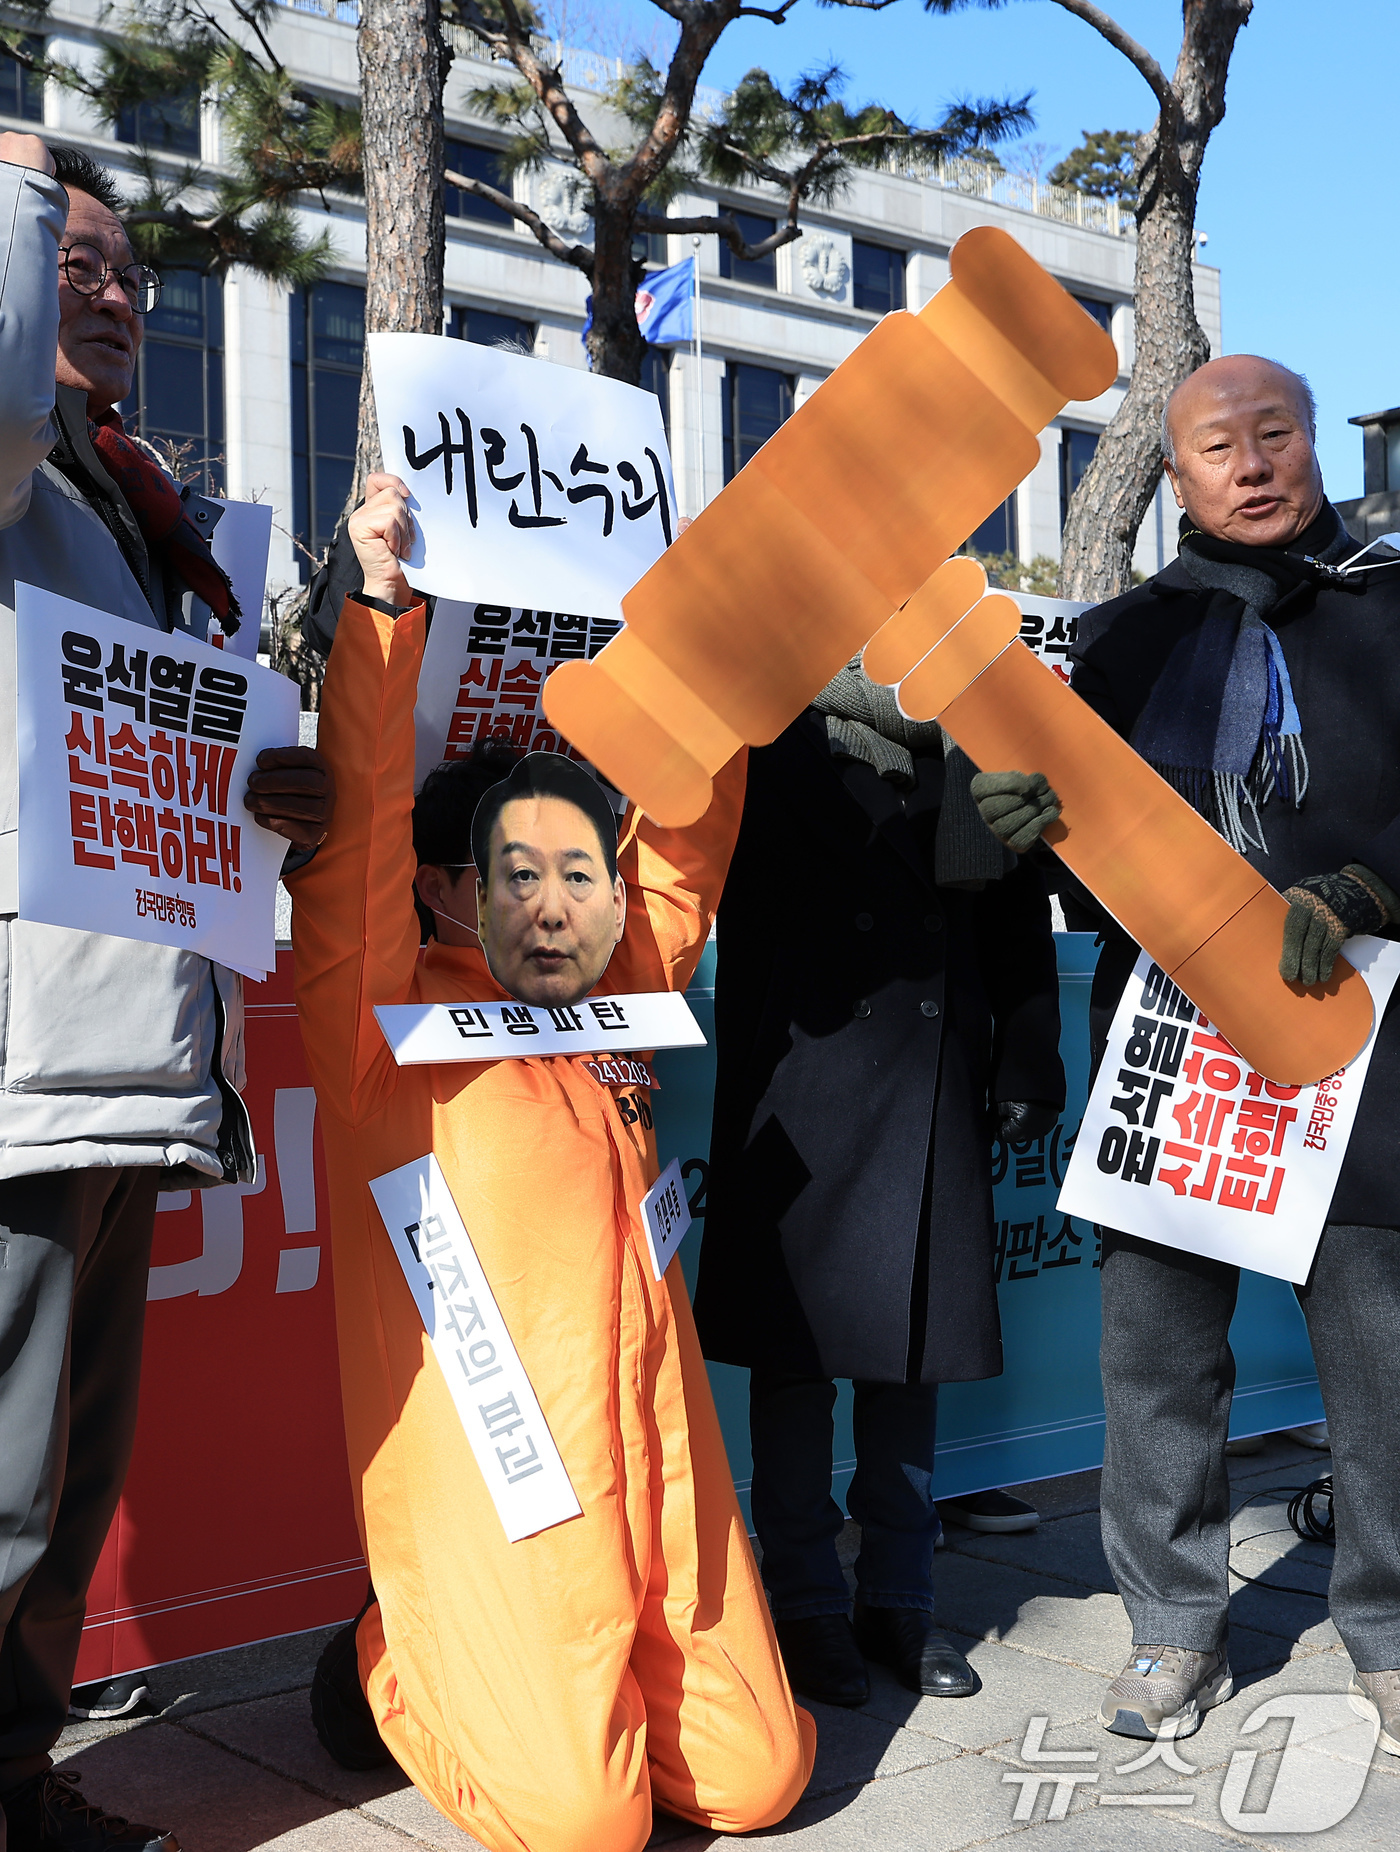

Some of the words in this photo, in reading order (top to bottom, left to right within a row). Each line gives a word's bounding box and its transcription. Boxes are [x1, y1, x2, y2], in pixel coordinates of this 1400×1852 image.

[61, 630, 248, 744] 윤석열을
[65, 711, 238, 816] 신속하게
[69, 790, 242, 894] 탄핵하라!
[448, 1001, 630, 1038] 민생파탄
[589, 1060, 651, 1086] 241203
[1157, 1012, 1243, 1201] 신속하
[403, 1213, 503, 1386] 민주주의
[478, 1391, 543, 1485] 파괴
